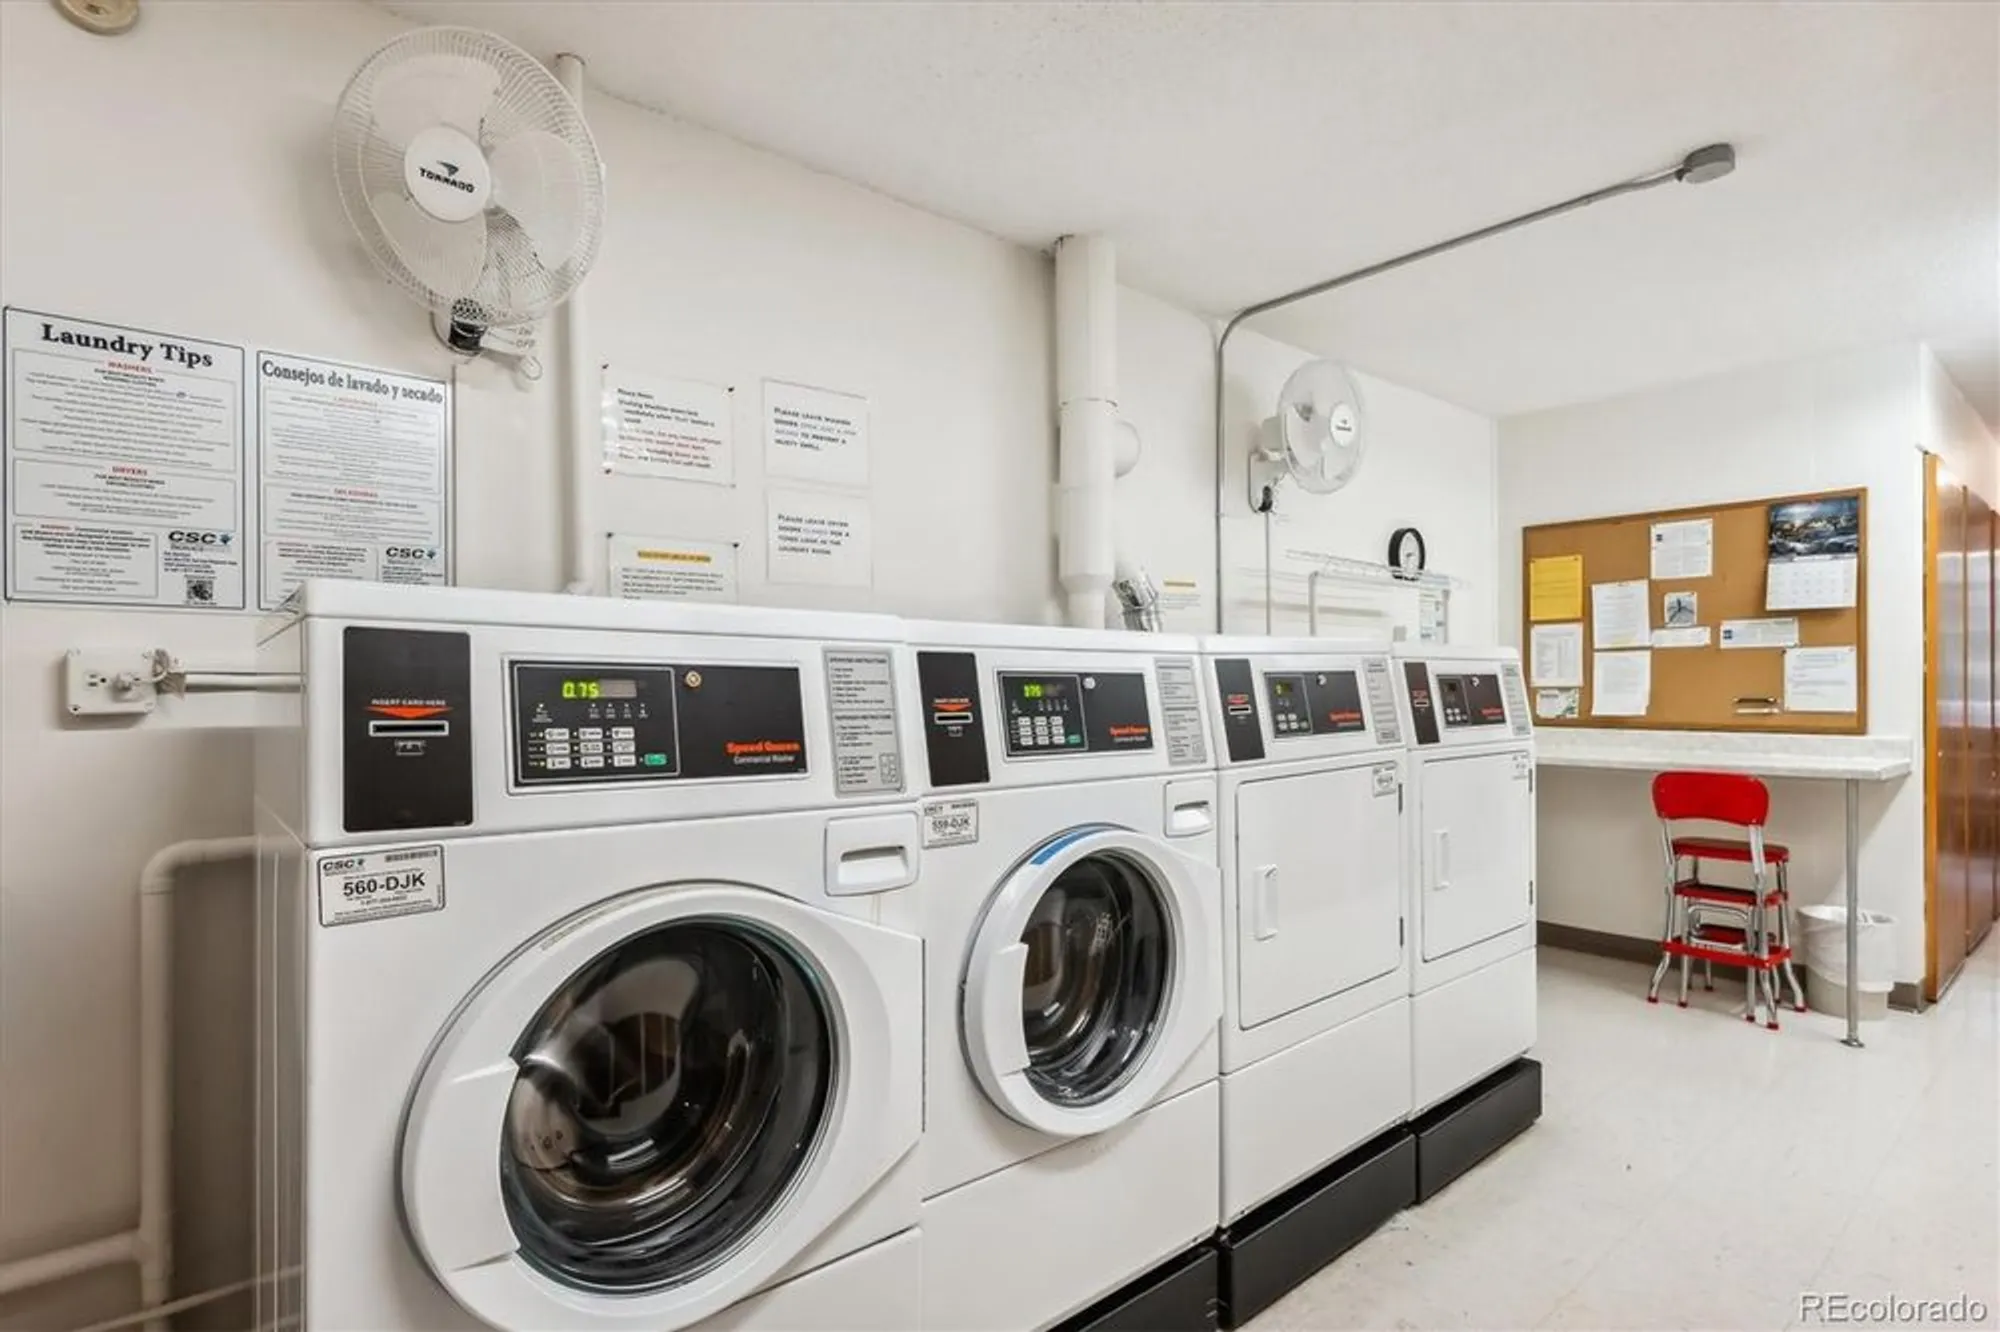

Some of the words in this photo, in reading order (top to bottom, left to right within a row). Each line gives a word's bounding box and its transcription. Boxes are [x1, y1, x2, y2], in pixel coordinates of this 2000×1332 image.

[418, 166, 475, 194] TORNADO
[41, 323, 153, 361] Laundry
[159, 343, 214, 370] Tips
[262, 360, 325, 387] Consejos
[328, 371, 344, 388] de
[346, 374, 389, 395] lavado
[391, 386, 400, 400] y
[402, 387, 443, 404] secado
[168, 530, 217, 545] CSC
[386, 546, 425, 560] CSC
[726, 741, 763, 754] Speed
[322, 859, 355, 871] CSC
[343, 872, 426, 897] 560-DJK
